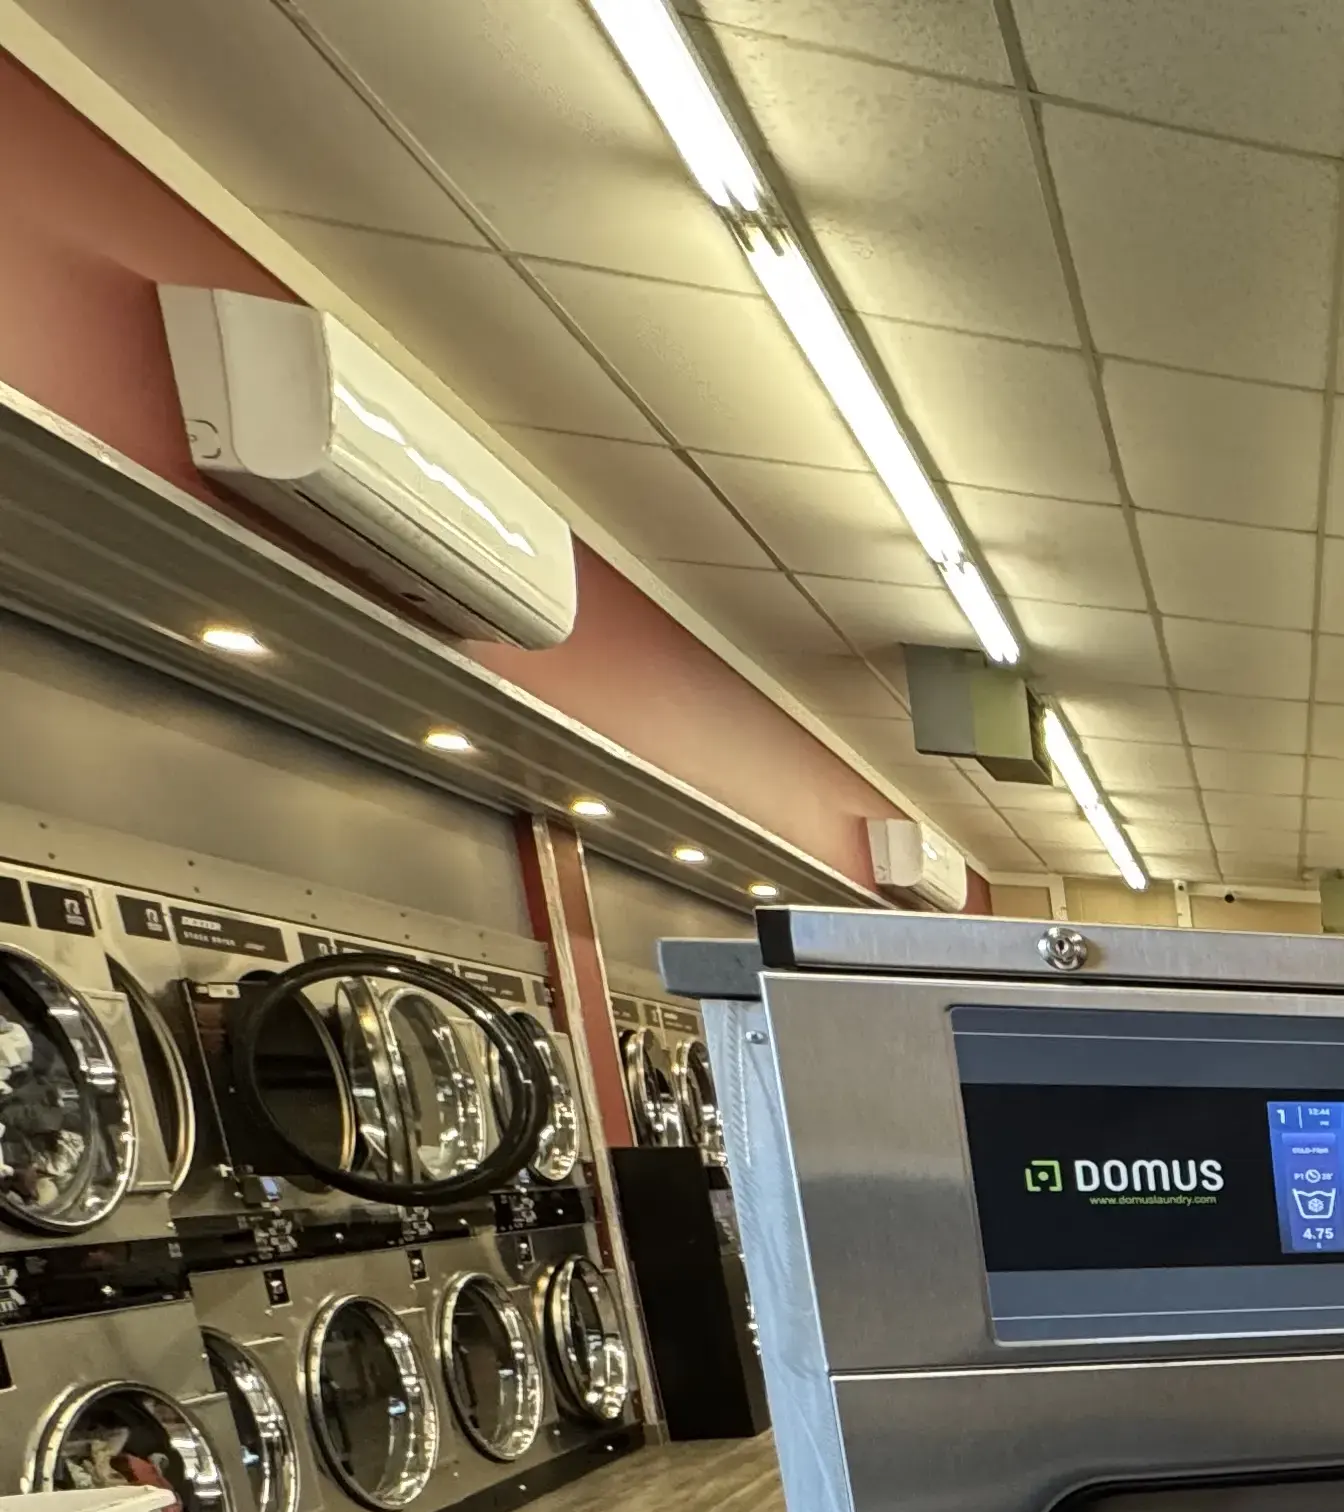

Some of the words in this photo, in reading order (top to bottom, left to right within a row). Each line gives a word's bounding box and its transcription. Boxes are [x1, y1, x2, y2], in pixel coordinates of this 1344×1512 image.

[1276, 1109, 1286, 1124] 1
[1074, 1159, 1225, 1193] DOMUS
[1089, 1194, 1218, 1206] www.domuslaundry.com
[1302, 1227, 1335, 1240] 4.75
